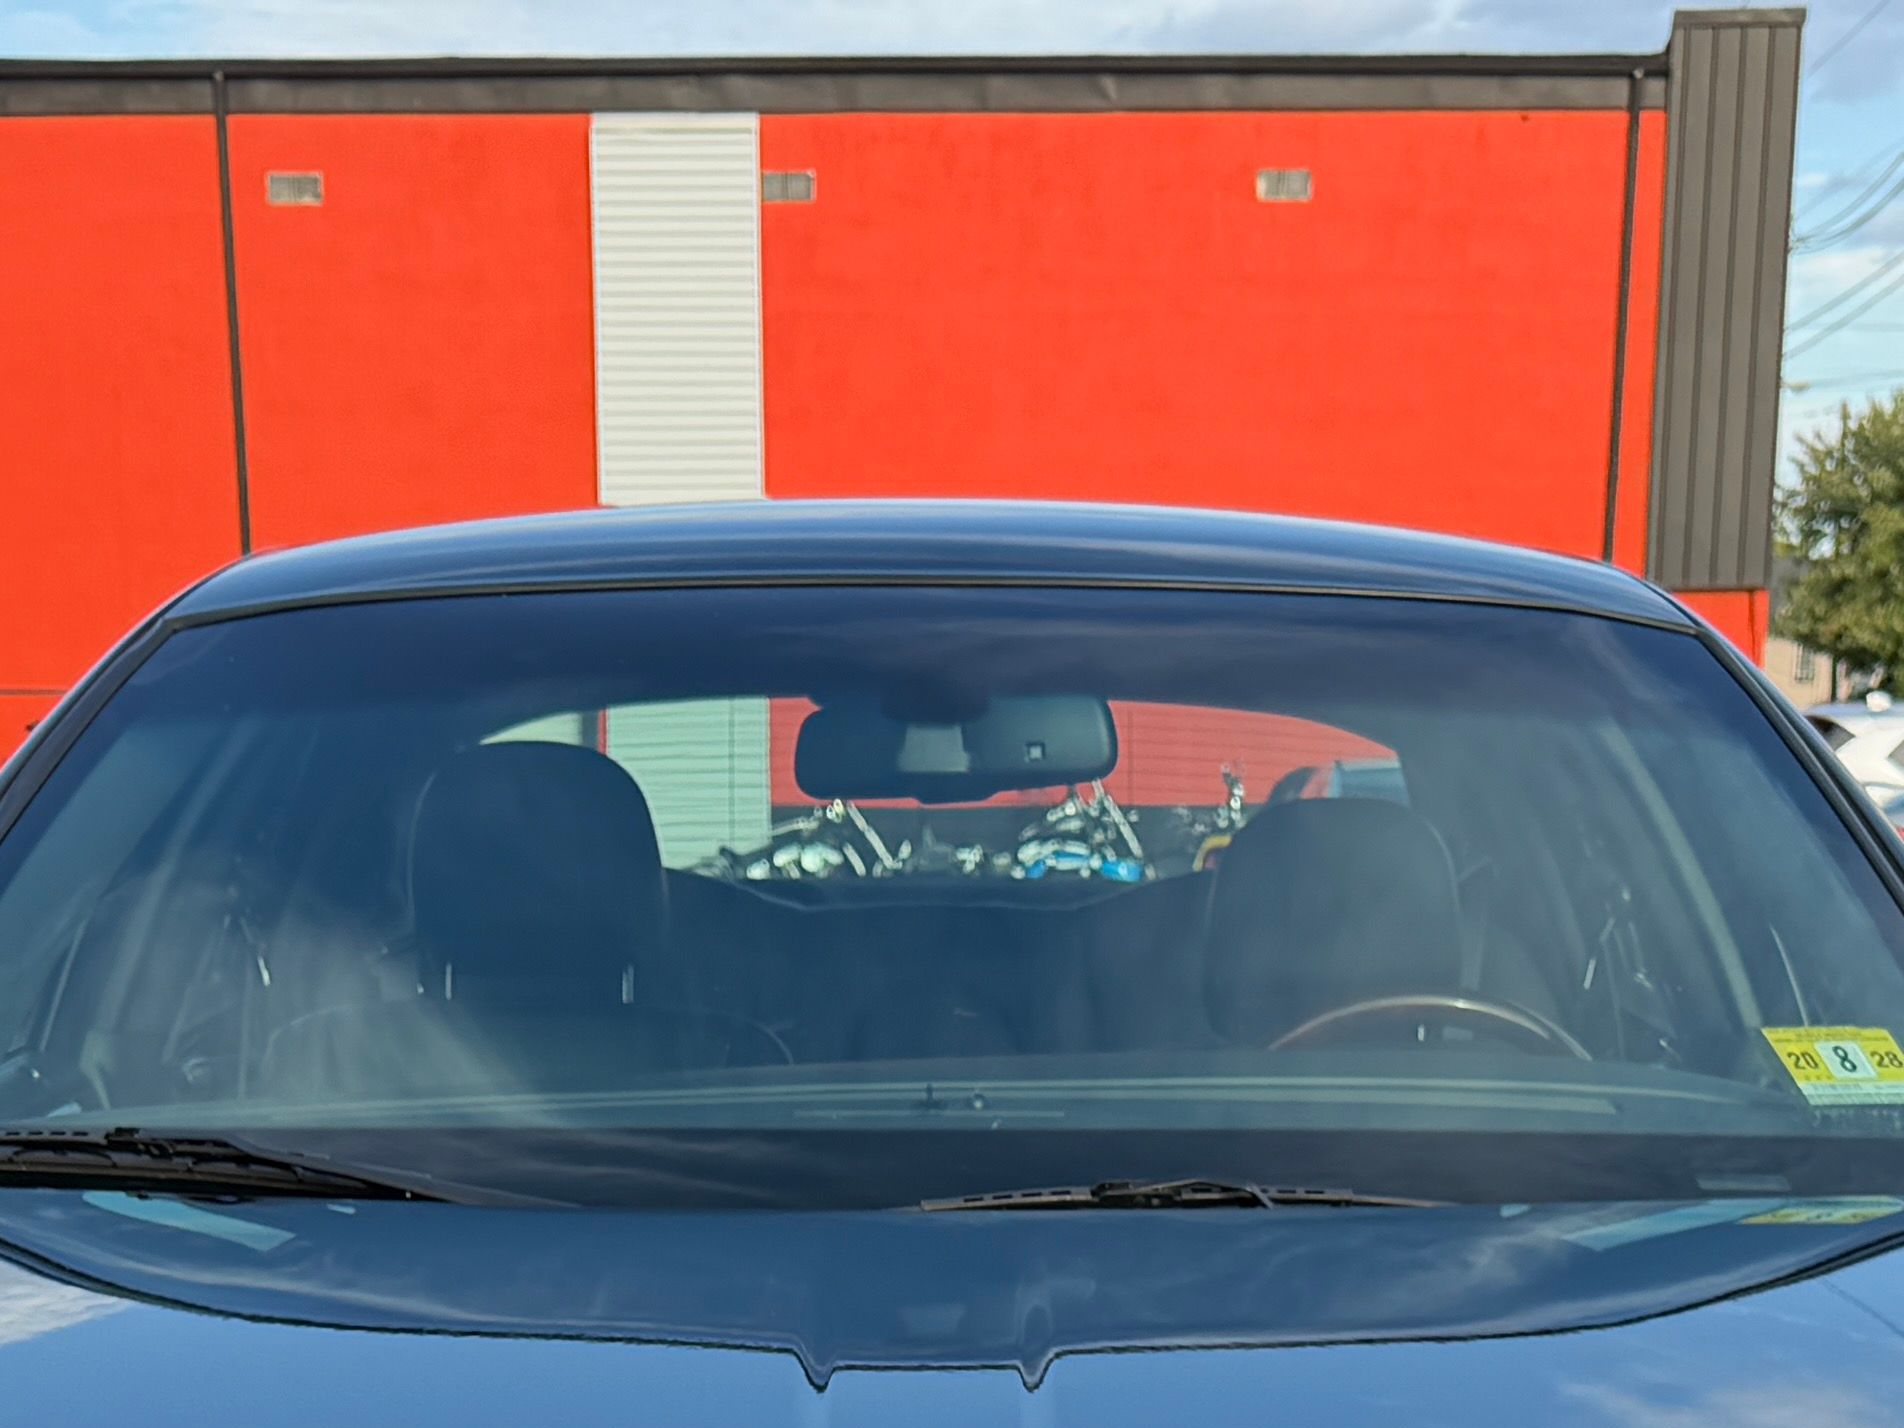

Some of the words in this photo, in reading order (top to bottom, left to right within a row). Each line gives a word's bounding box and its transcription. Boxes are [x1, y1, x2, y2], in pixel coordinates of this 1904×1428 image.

[1786, 1052, 1819, 1070] 20
[1832, 1045, 1857, 1073] 8
[1870, 1051, 1904, 1069] 28
